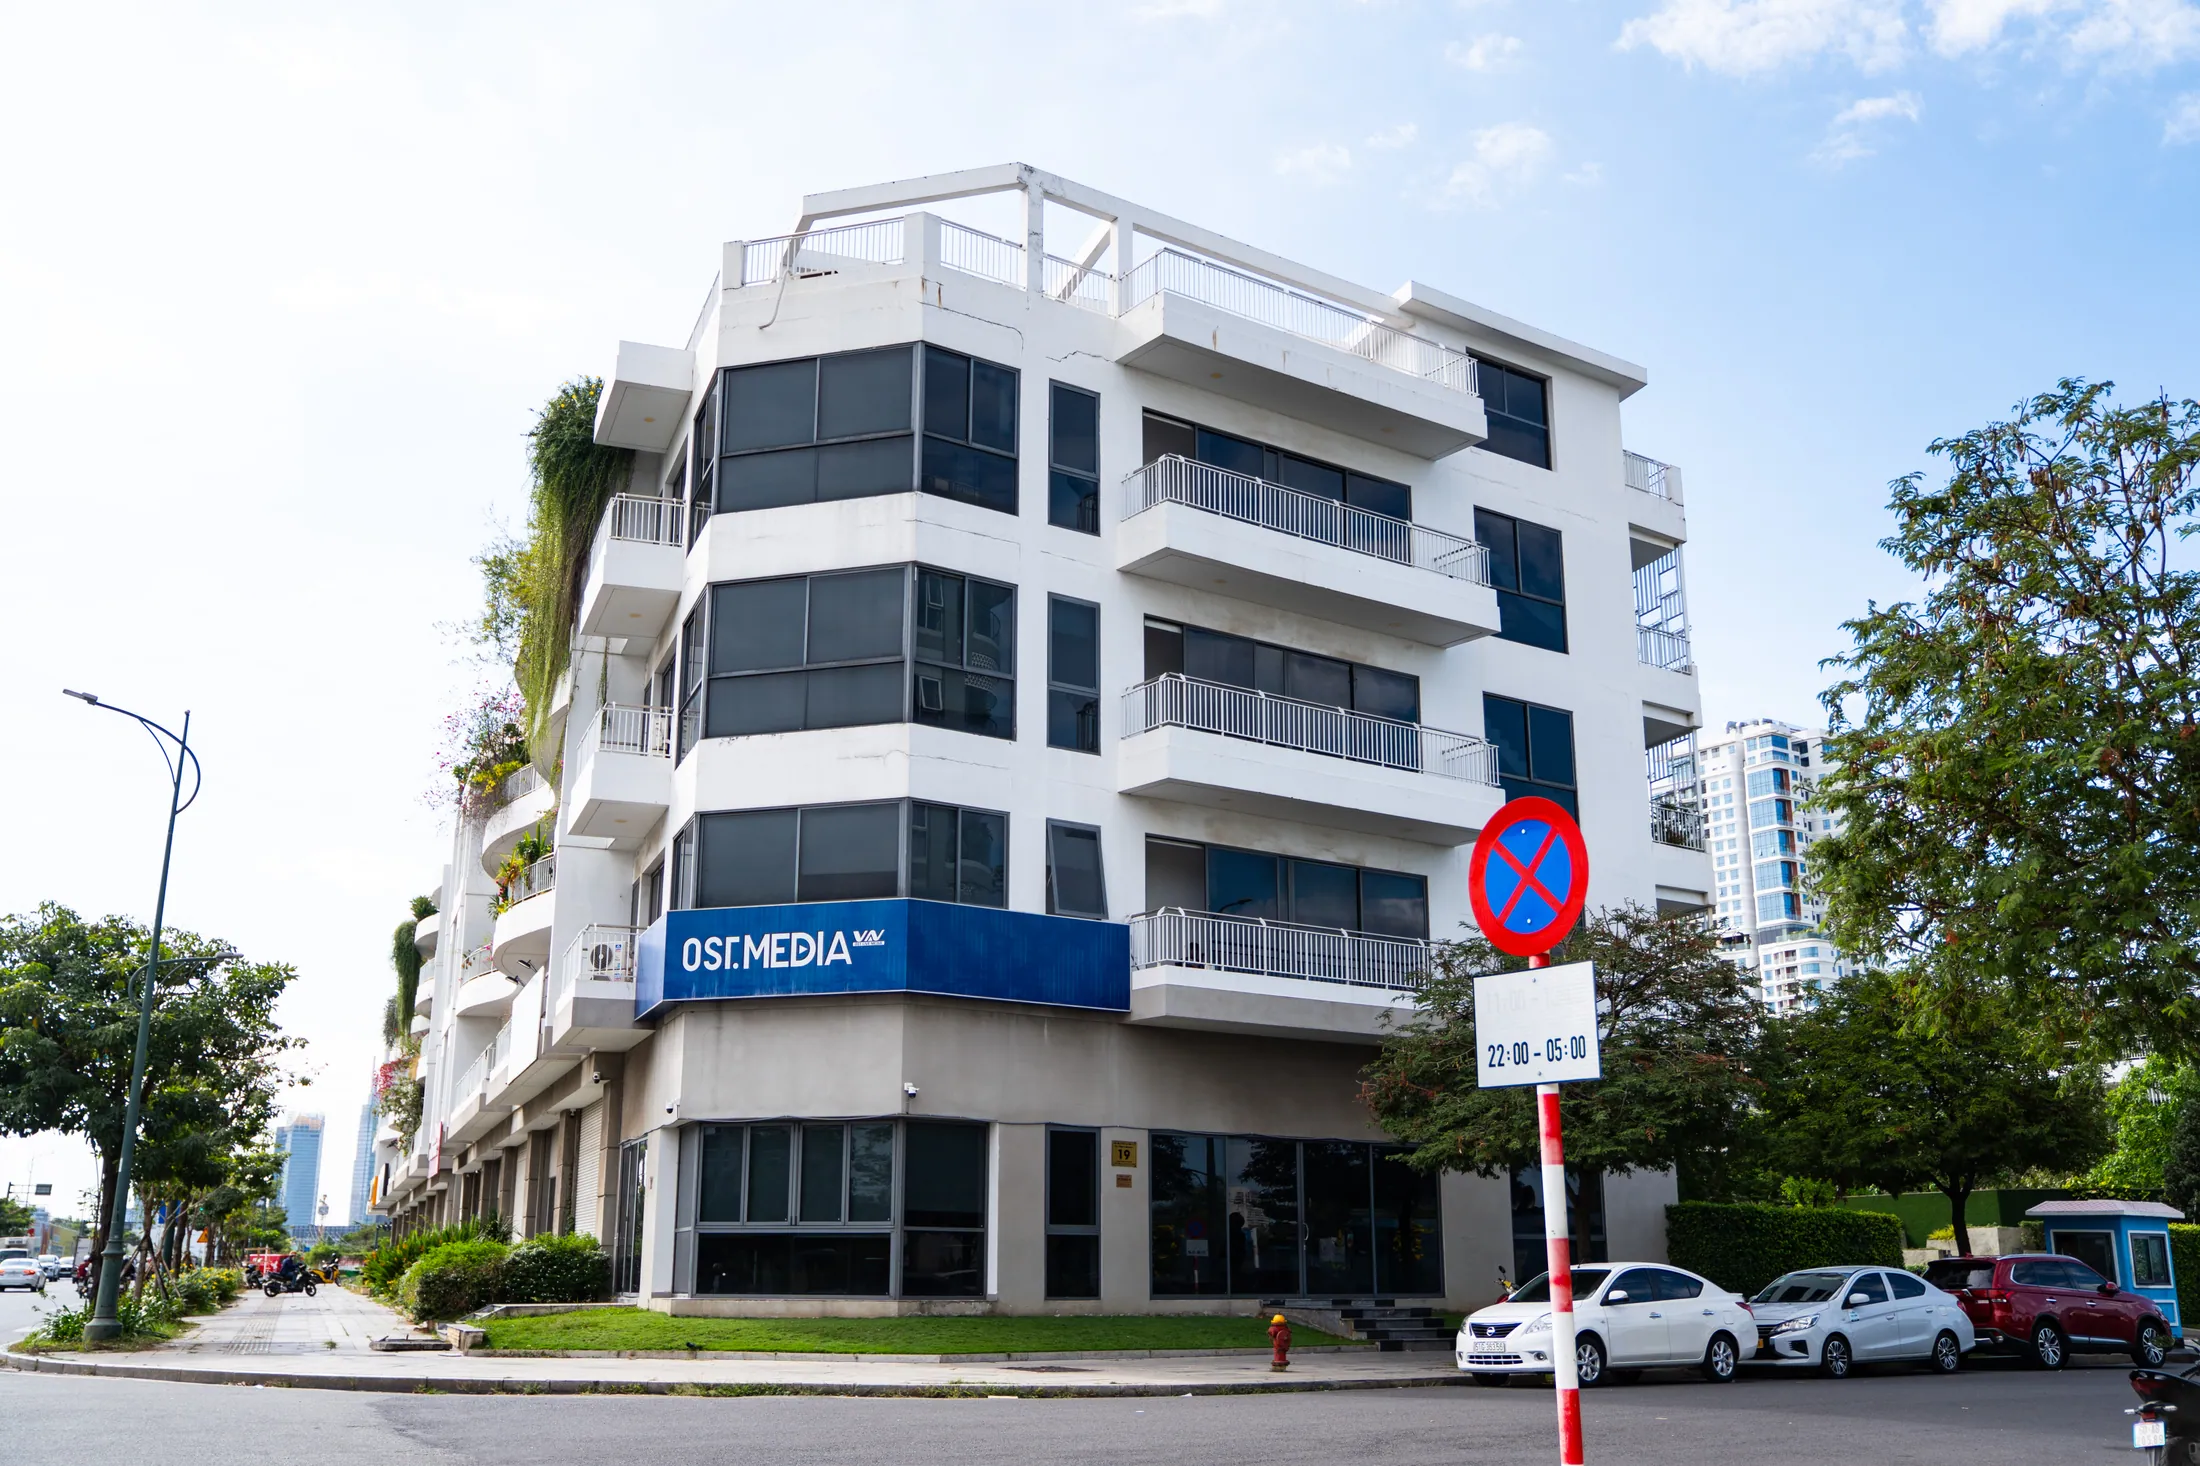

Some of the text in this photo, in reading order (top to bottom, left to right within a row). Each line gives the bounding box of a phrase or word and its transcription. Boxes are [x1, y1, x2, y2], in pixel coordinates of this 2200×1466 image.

[1488, 1041, 1529, 1068] 22:00
[1546, 1035, 1586, 1062] 05:00
[1117, 1149, 1131, 1160] 19
